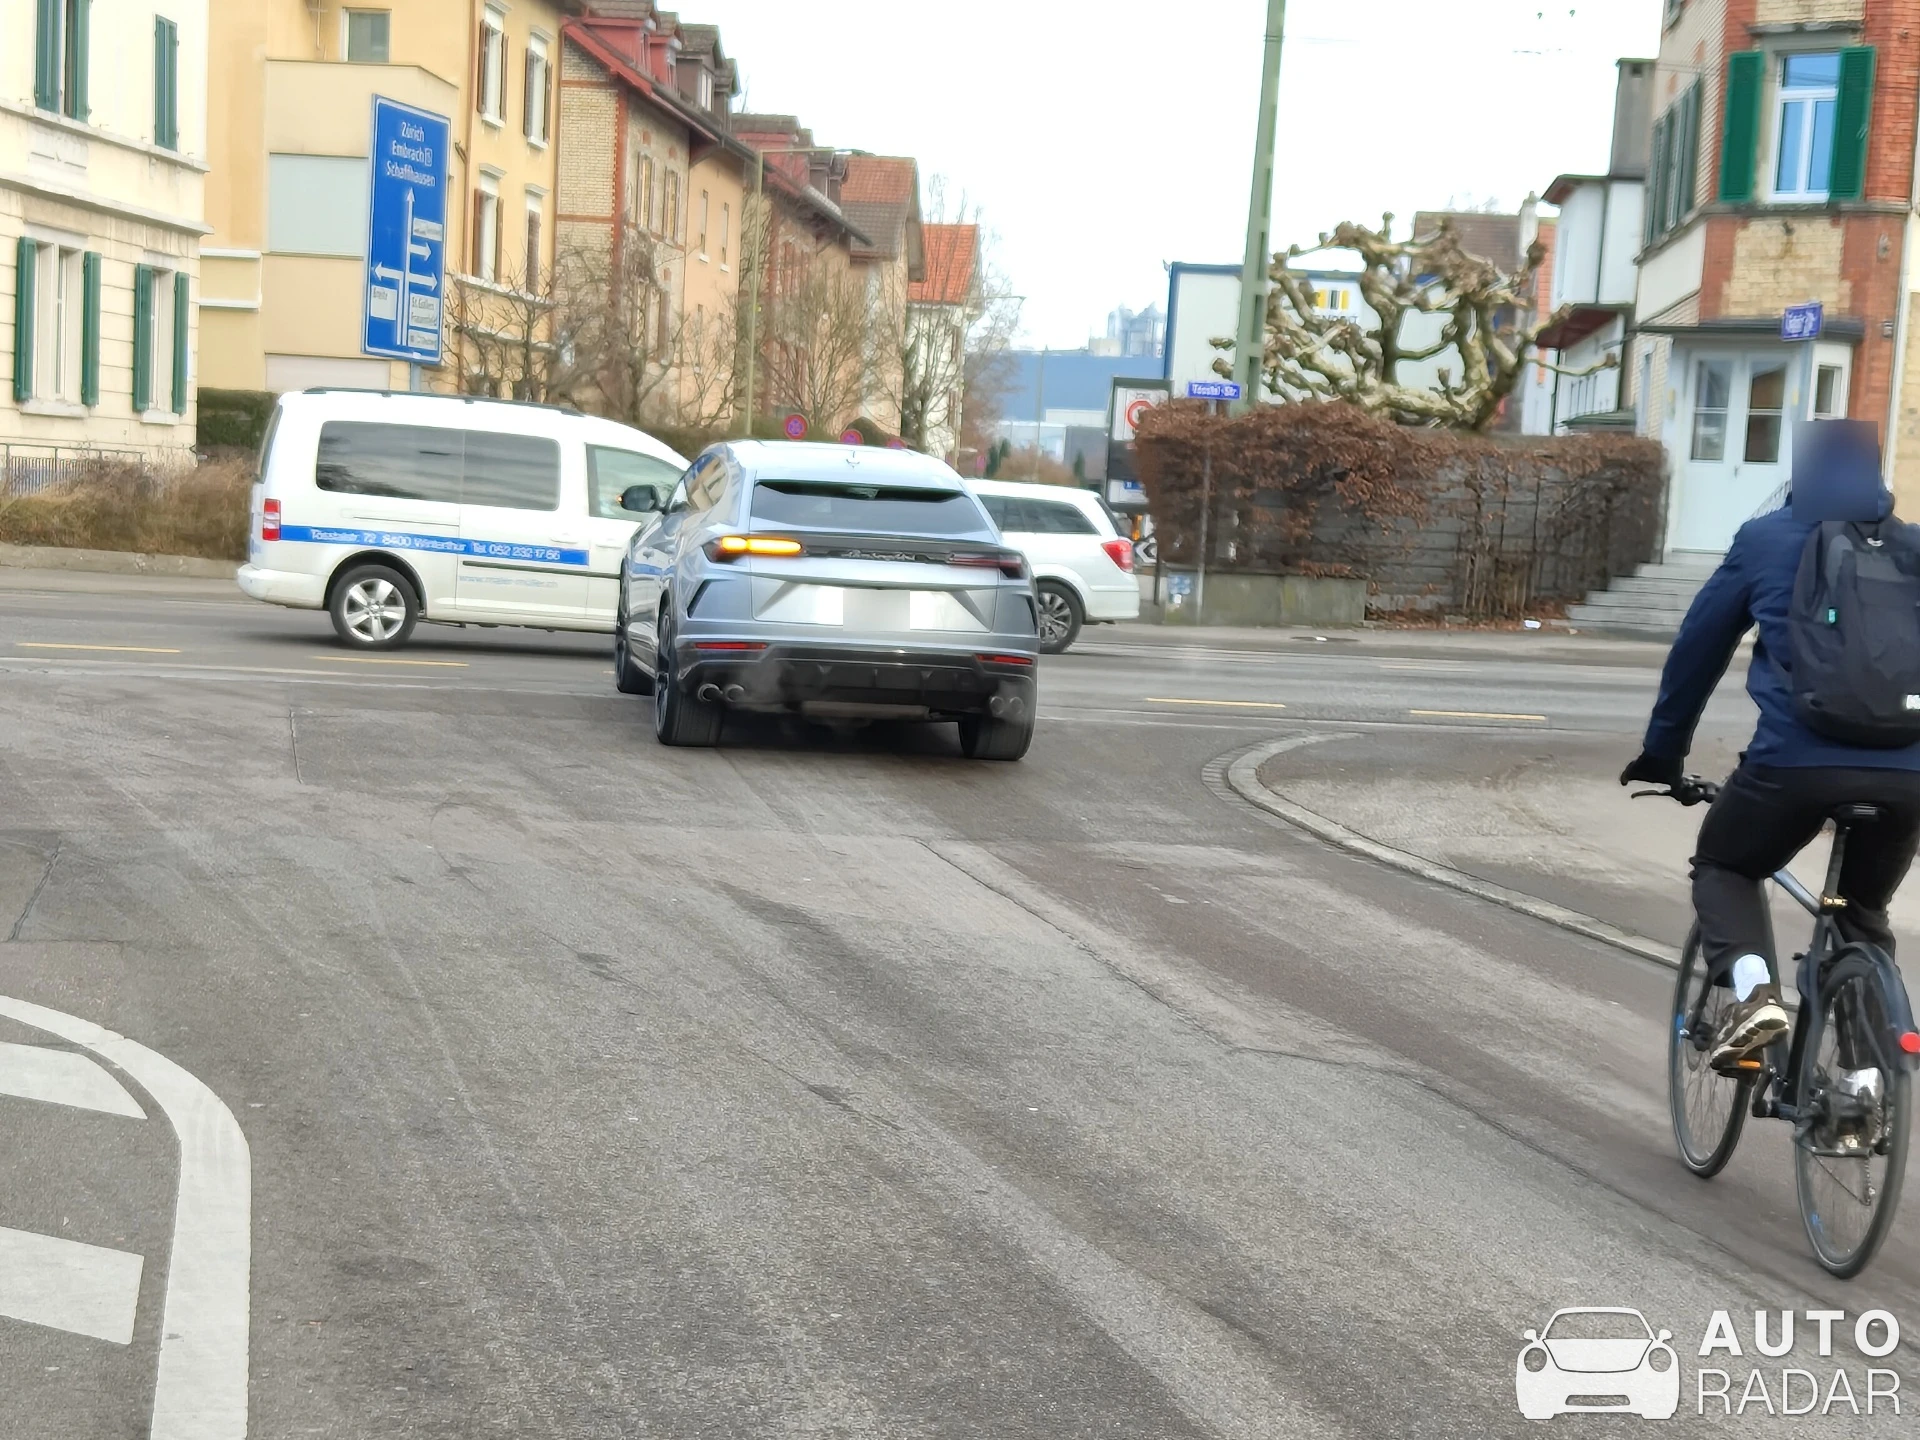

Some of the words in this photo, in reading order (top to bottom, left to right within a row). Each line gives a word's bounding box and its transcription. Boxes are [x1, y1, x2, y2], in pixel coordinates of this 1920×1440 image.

[401, 121, 425, 143] Zürich
[392, 140, 425, 163] Embrach
[386, 160, 436, 187] Schaffhausen
[381, 534, 412, 547] 8400
[414, 538, 467, 551] Winterthur
[489, 543, 511, 557] 052
